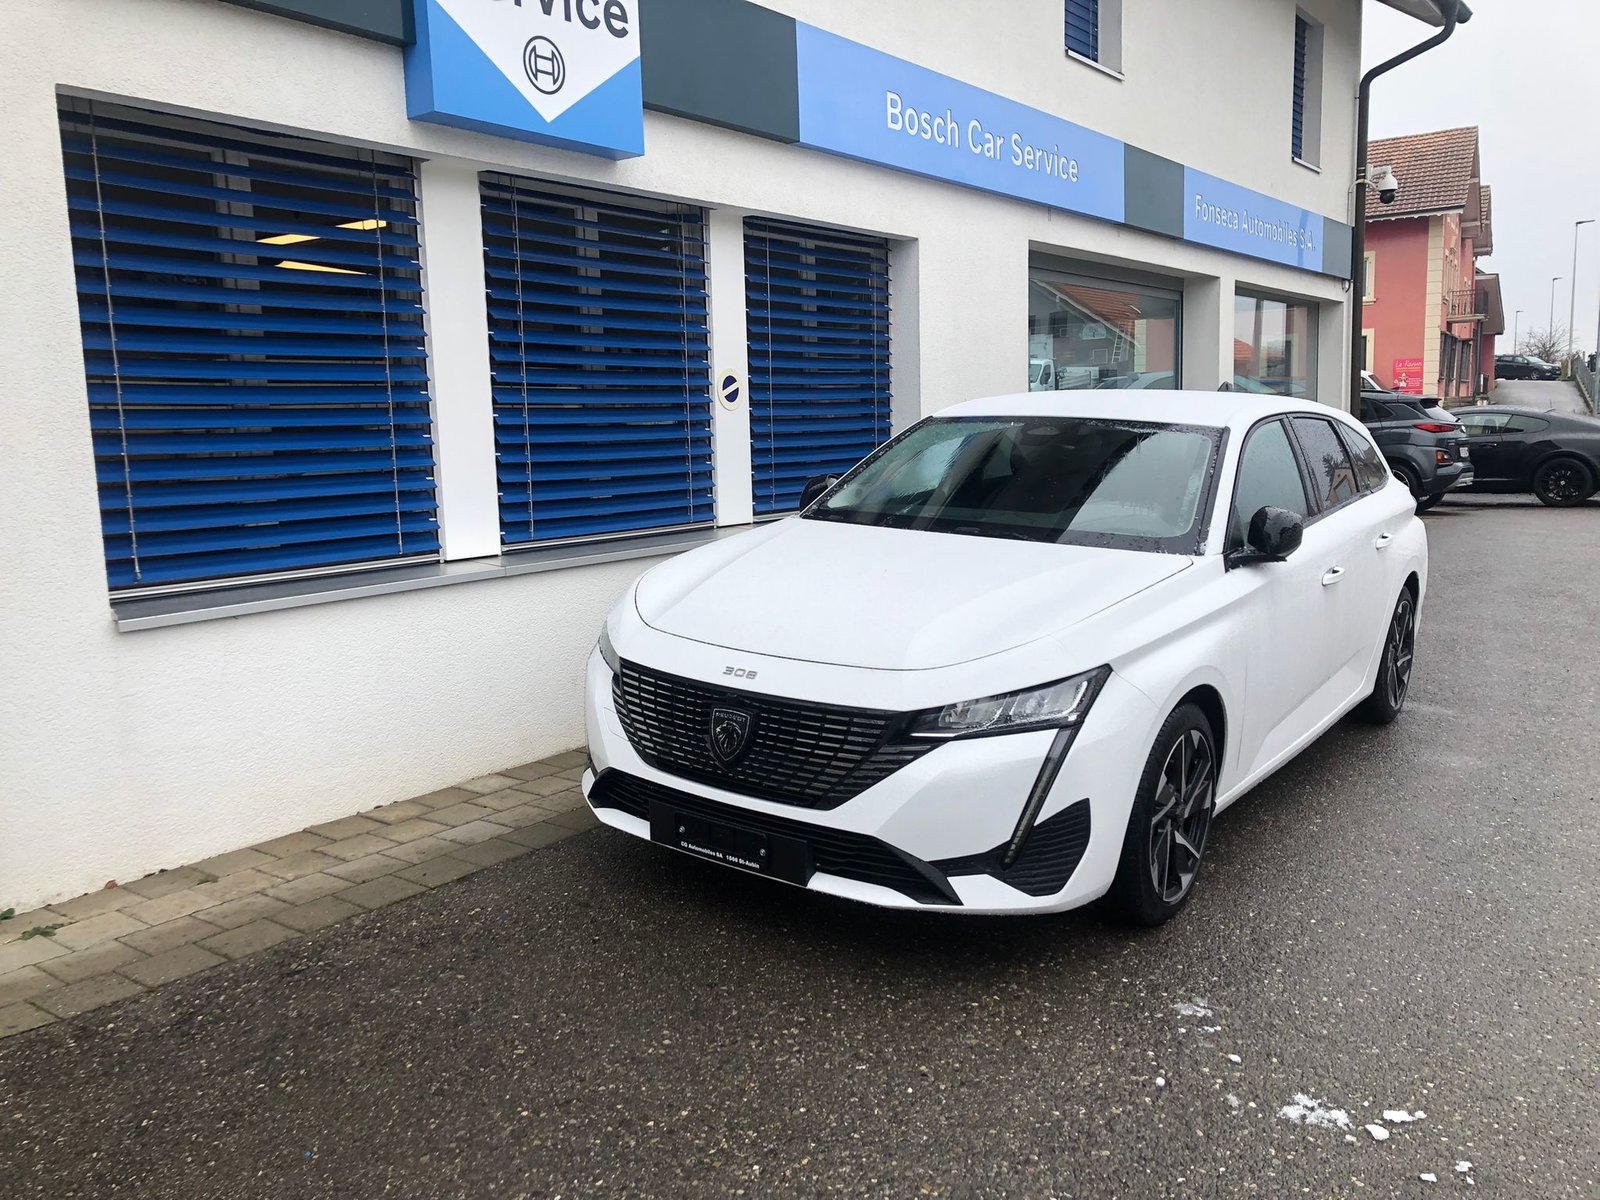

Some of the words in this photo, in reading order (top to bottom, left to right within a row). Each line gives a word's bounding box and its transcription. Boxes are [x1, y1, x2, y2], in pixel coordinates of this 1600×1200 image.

[886, 90, 960, 149] Bosch
[967, 118, 1005, 160] Car
[1011, 132, 1080, 183] Service
[1194, 193, 1240, 231] Fonseca
[1242, 210, 1298, 248] Automobiles
[722, 665, 758, 680] 308
[688, 843, 716, 856] Automobiles
